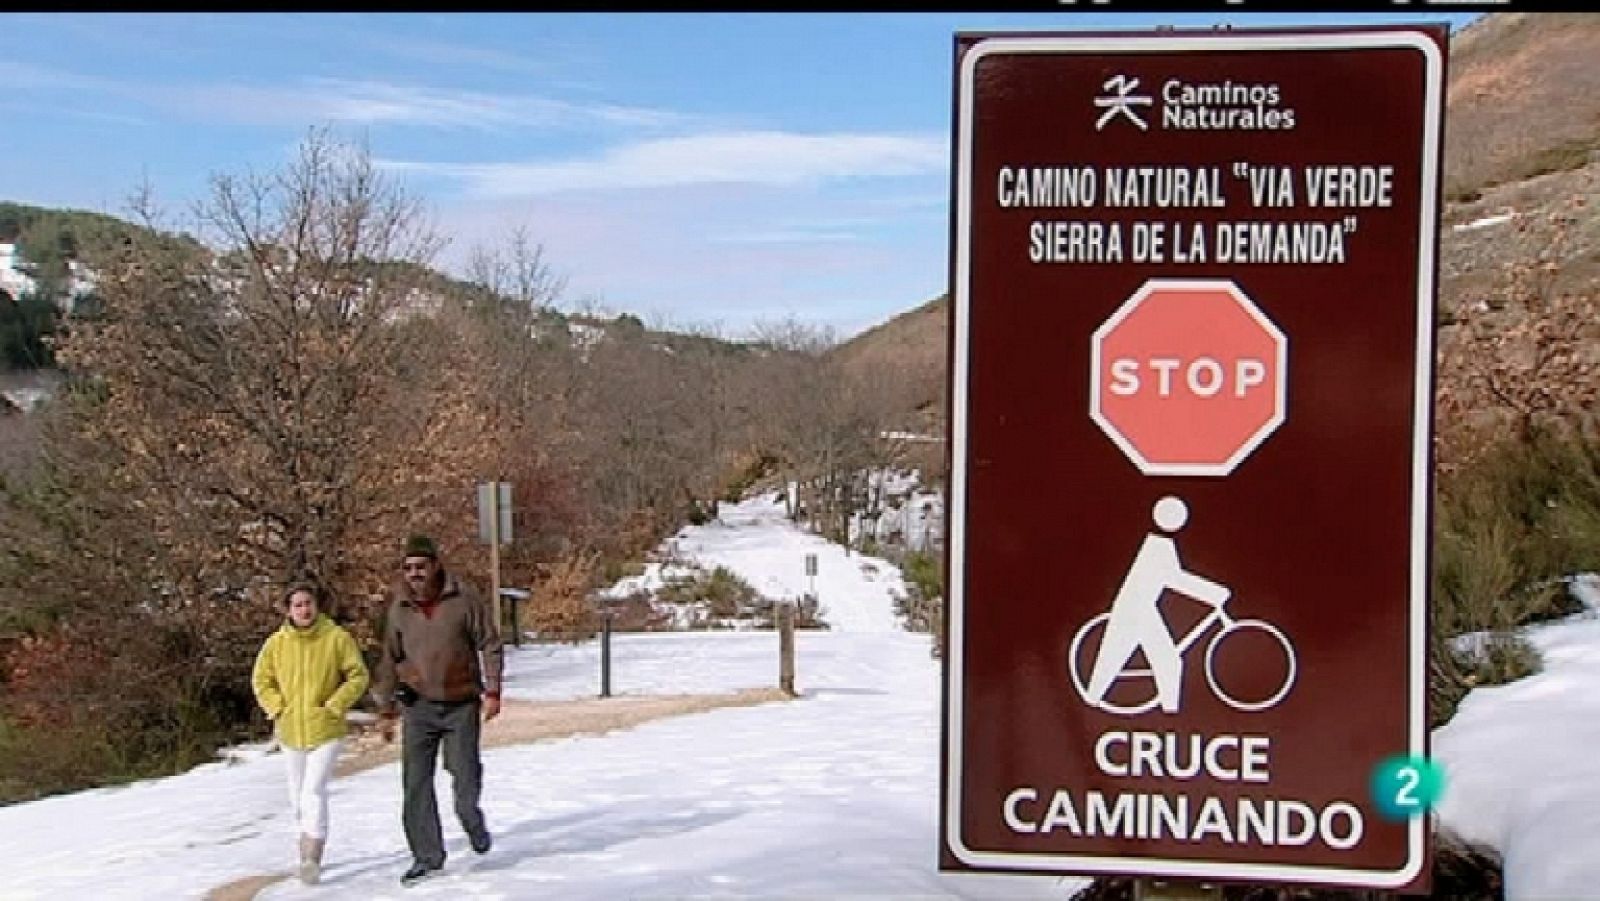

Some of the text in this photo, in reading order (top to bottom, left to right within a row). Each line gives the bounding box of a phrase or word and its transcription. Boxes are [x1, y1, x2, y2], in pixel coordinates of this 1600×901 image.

[1162, 80, 1280, 105] Caminos
[1162, 104, 1295, 130] Naturales
[998, 166, 1097, 208] CAMINO
[1105, 167, 1226, 208] NATURAL
[1305, 166, 1393, 208] VERDE
[1029, 221, 1124, 263] SIERRA
[1132, 222, 1165, 263] DE
[1172, 222, 1207, 263] LA
[1109, 357, 1266, 398] STOP
[1094, 731, 1270, 783] CRUCE
[1003, 788, 1363, 850] CAMINANDO
